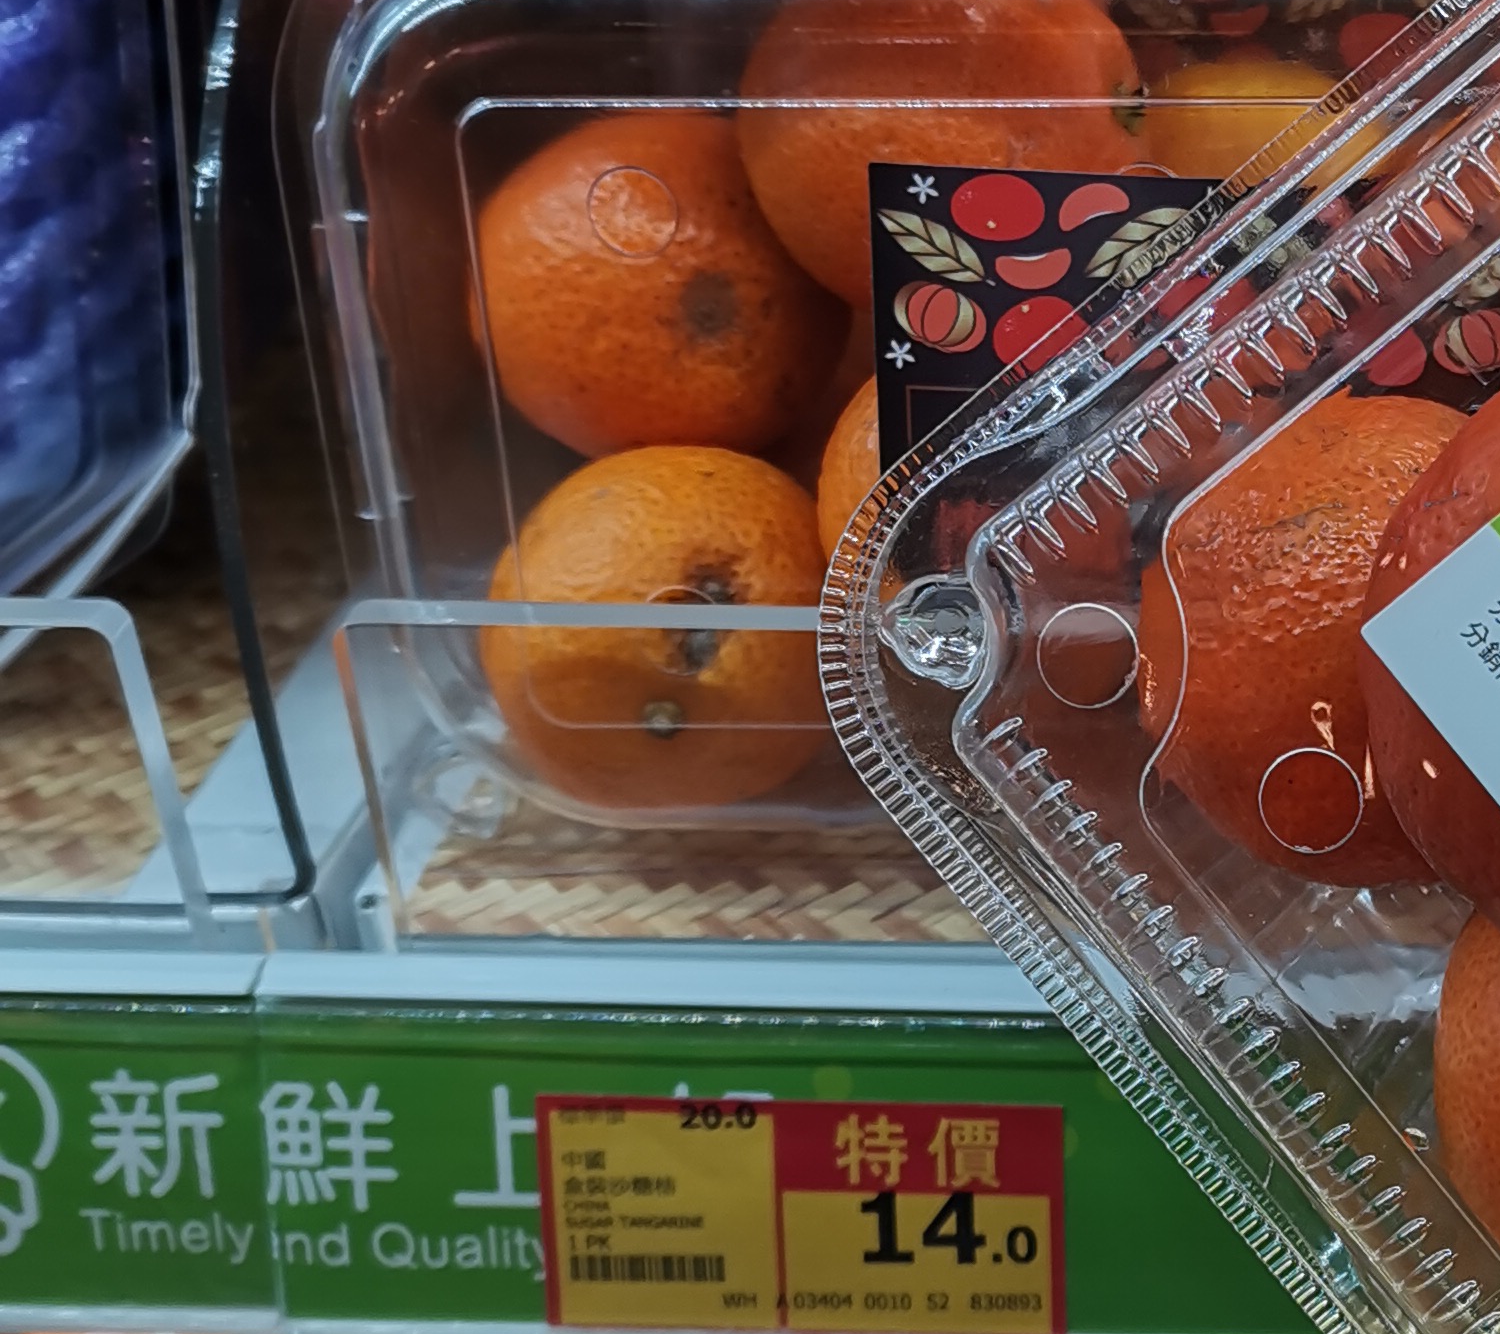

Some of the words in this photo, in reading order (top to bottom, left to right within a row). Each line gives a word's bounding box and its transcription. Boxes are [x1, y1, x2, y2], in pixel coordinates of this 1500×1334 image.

[679, 1102, 758, 1131] 20.0
[834, 1113, 1002, 1188] 特價
[78, 1207, 254, 1265] Timely
[859, 1190, 1039, 1265] 14.0
[722, 1292, 758, 1310] WH
[863, 1292, 913, 1312] 0010
[926, 1292, 950, 1313] 52
[969, 1292, 1044, 1314] 830893
